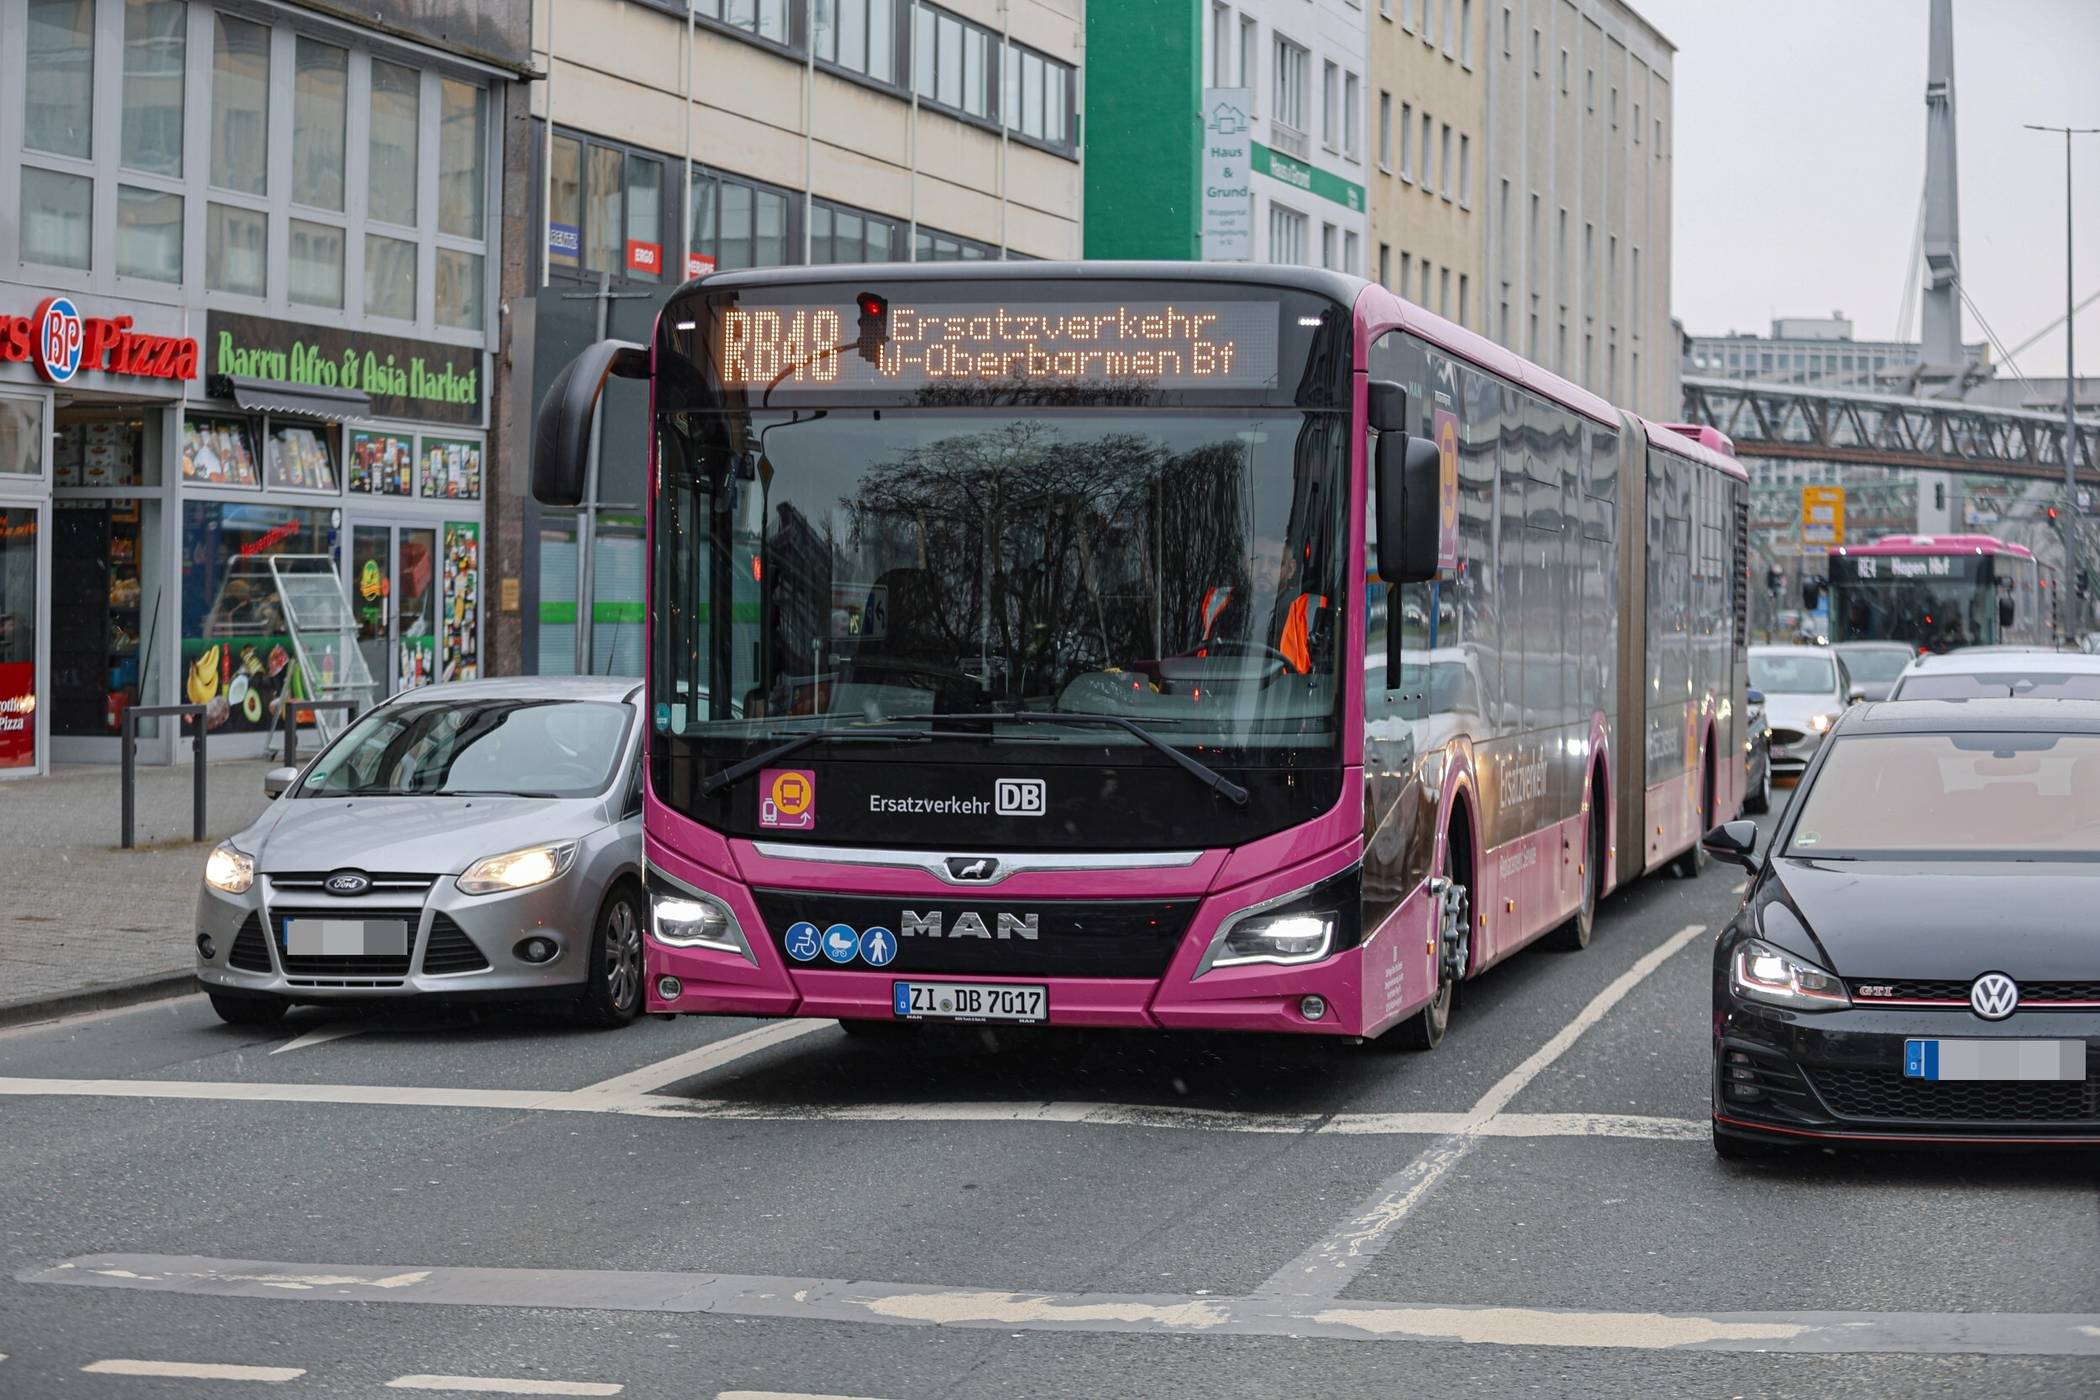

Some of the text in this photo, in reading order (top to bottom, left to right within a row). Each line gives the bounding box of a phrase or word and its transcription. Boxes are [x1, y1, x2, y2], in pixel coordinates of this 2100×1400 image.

[1210, 147, 1243, 158] Haus
[1222, 167, 1233, 178] &
[1207, 186, 1248, 198] Grund
[635, 248, 654, 264] ERGO
[47, 310, 82, 372] BP
[80, 315, 199, 380] Pizza
[724, 306, 1217, 382] RB48 Ersatzverkehr
[290, 341, 338, 387] Afro
[340, 348, 360, 389] &
[363, 350, 408, 396] Asia
[410, 356, 478, 404] Market
[879, 341, 1233, 376] W-Oberbarmen Bf
[1500, 748, 1548, 808] Ersatzverkehr
[870, 782, 1042, 815] Ersatzverkehr DB
[334, 877, 359, 889] Ford
[901, 910, 1039, 940] MAN
[911, 988, 937, 1011] ZI
[955, 989, 982, 1013] DB
[988, 990, 1041, 1015] 7017
[1859, 985, 1893, 997] GTI
[1971, 974, 2017, 1018] VW
[1910, 1062, 1917, 1070] D
